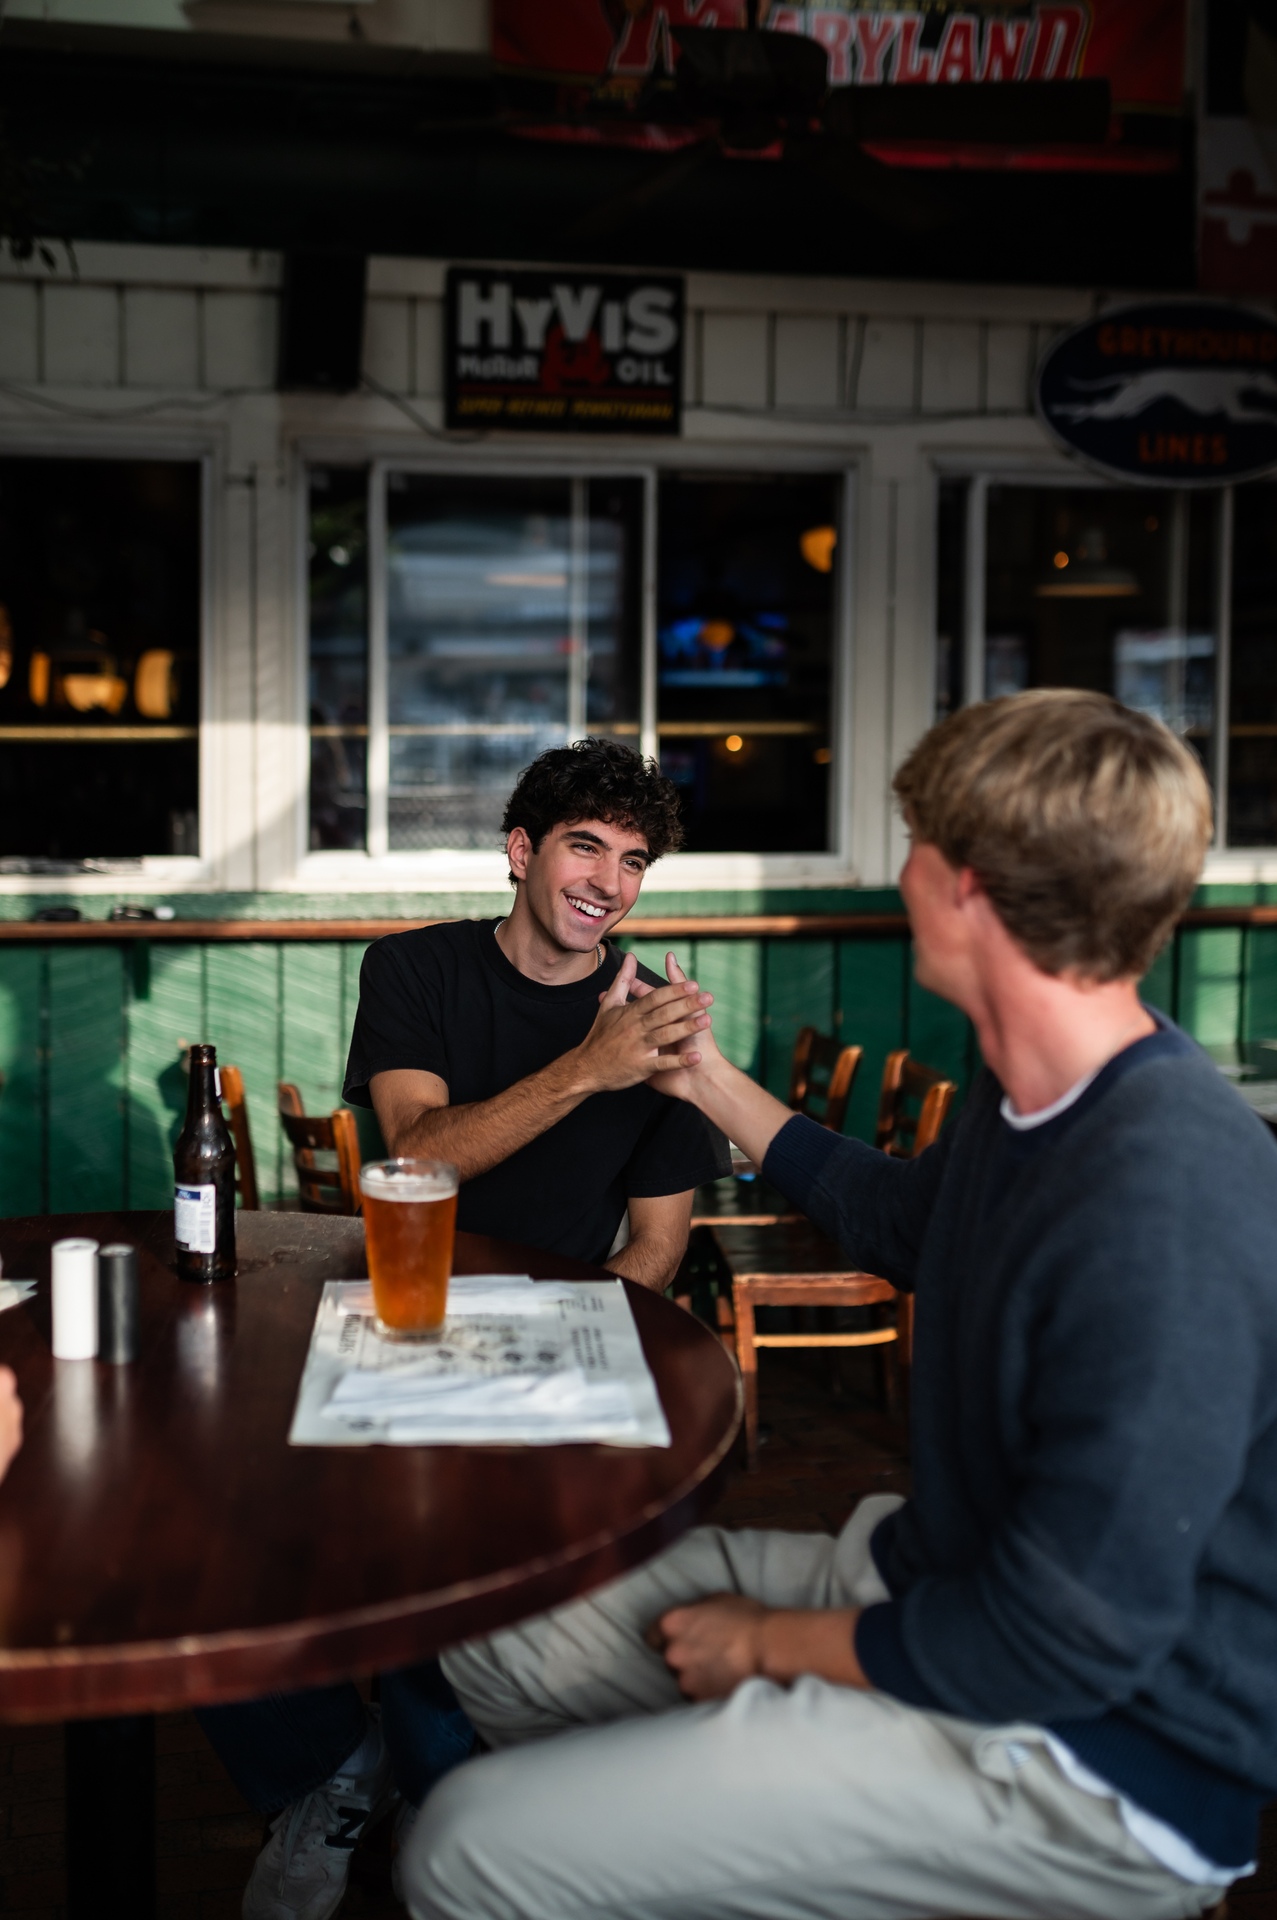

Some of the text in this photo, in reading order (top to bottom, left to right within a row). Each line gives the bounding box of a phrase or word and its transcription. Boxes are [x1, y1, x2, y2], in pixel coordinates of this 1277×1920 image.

[1097, 323, 1277, 363] GREYHOUND
[614, 356, 675, 384] OIL
[1137, 431, 1229, 466] LINES
